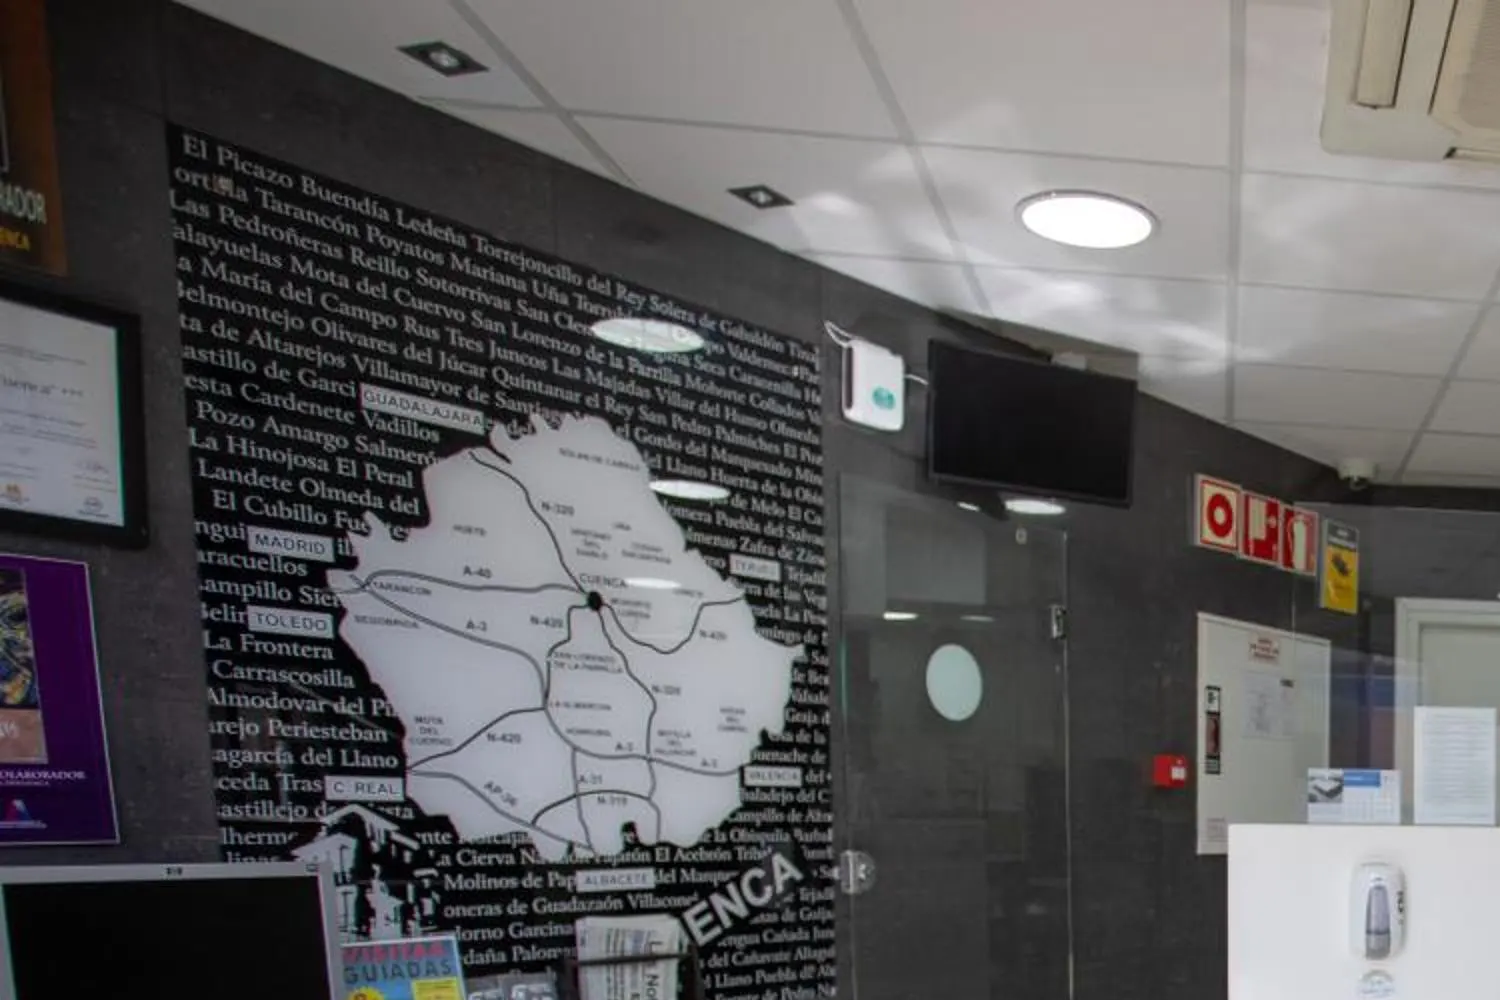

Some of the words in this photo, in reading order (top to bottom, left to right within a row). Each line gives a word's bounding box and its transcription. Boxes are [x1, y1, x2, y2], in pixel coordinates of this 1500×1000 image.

[183, 133, 207, 160] El
[217, 146, 293, 189] Picazo
[301, 175, 389, 223] Buendía
[396, 208, 467, 249] Ledeña
[471, 233, 582, 287] Torrejoncillo
[587, 272, 610, 297] del
[616, 282, 645, 310] Rey
[168, 189, 210, 219] Las
[218, 204, 344, 260] Pedroñeras
[350, 245, 412, 281] Reillo
[416, 267, 511, 311] Sotorrivas
[516, 299, 548, 324] San
[255, 187, 359, 238] Tarancón
[365, 223, 444, 266] Poyatos
[450, 252, 527, 292] Mariana
[532, 279, 568, 307] Uña
[170, 222, 284, 269] alayuelas
[289, 254, 349, 290] Mota
[356, 276, 388, 301] del
[393, 287, 465, 322] Cuervo
[471, 308, 506, 335] San
[512, 321, 581, 357] Lorenzo
[585, 343, 605, 365] de
[609, 350, 623, 371] la
[200, 257, 273, 296] María
[279, 281, 314, 307] del
[320, 292, 398, 330] Campo
[403, 315, 440, 341] Rus
[444, 325, 484, 353] Tres
[489, 338, 548, 371] Juncos
[552, 357, 580, 381] Las
[210, 319, 240, 343] de
[246, 329, 347, 367] Altarejos
[352, 354, 462, 397] Villamayor
[466, 384, 490, 405] de
[311, 316, 398, 355] Olivares
[403, 341, 433, 365] del
[438, 350, 488, 381] Júcar
[491, 366, 582, 404] Quintanar
[264, 360, 291, 382] de
[297, 368, 357, 398] Garci
[240, 383, 356, 425] Cardenete
[362, 411, 440, 443] Vadillos
[197, 399, 256, 430] Pozo
[263, 415, 349, 451] Amargo
[355, 433, 442, 467] Salmeró
[191, 426, 220, 451] La
[226, 435, 329, 473] Hinojosa
[336, 457, 357, 478] El
[364, 463, 415, 489] Peral
[198, 457, 295, 494] Landete
[300, 477, 384, 510] Olmeda
[389, 497, 421, 517] del
[213, 490, 236, 511] El
[244, 496, 328, 527] Cubillo
[255, 533, 326, 555] MADRID
[198, 578, 293, 607] ampillo
[256, 612, 326, 631] TOLEDO
[203, 630, 232, 651] La
[240, 633, 334, 661] Frontera
[213, 659, 355, 689] Carrascosilla
[334, 695, 365, 716] del
[268, 718, 388, 743] Periesteban
[300, 747, 333, 766] del
[340, 748, 397, 768] Llano
[281, 774, 323, 794] Tras
[355, 782, 399, 795] REAL
[215, 801, 307, 823] astillejo
[456, 849, 515, 866] Cierva
[444, 872, 519, 891] Molinos
[522, 871, 543, 889] de
[444, 902, 502, 918] oneras
[507, 899, 528, 916] de
[682, 851, 803, 946] ENCA
[343, 958, 452, 984] GUIADAS
[463, 947, 506, 966] daña
